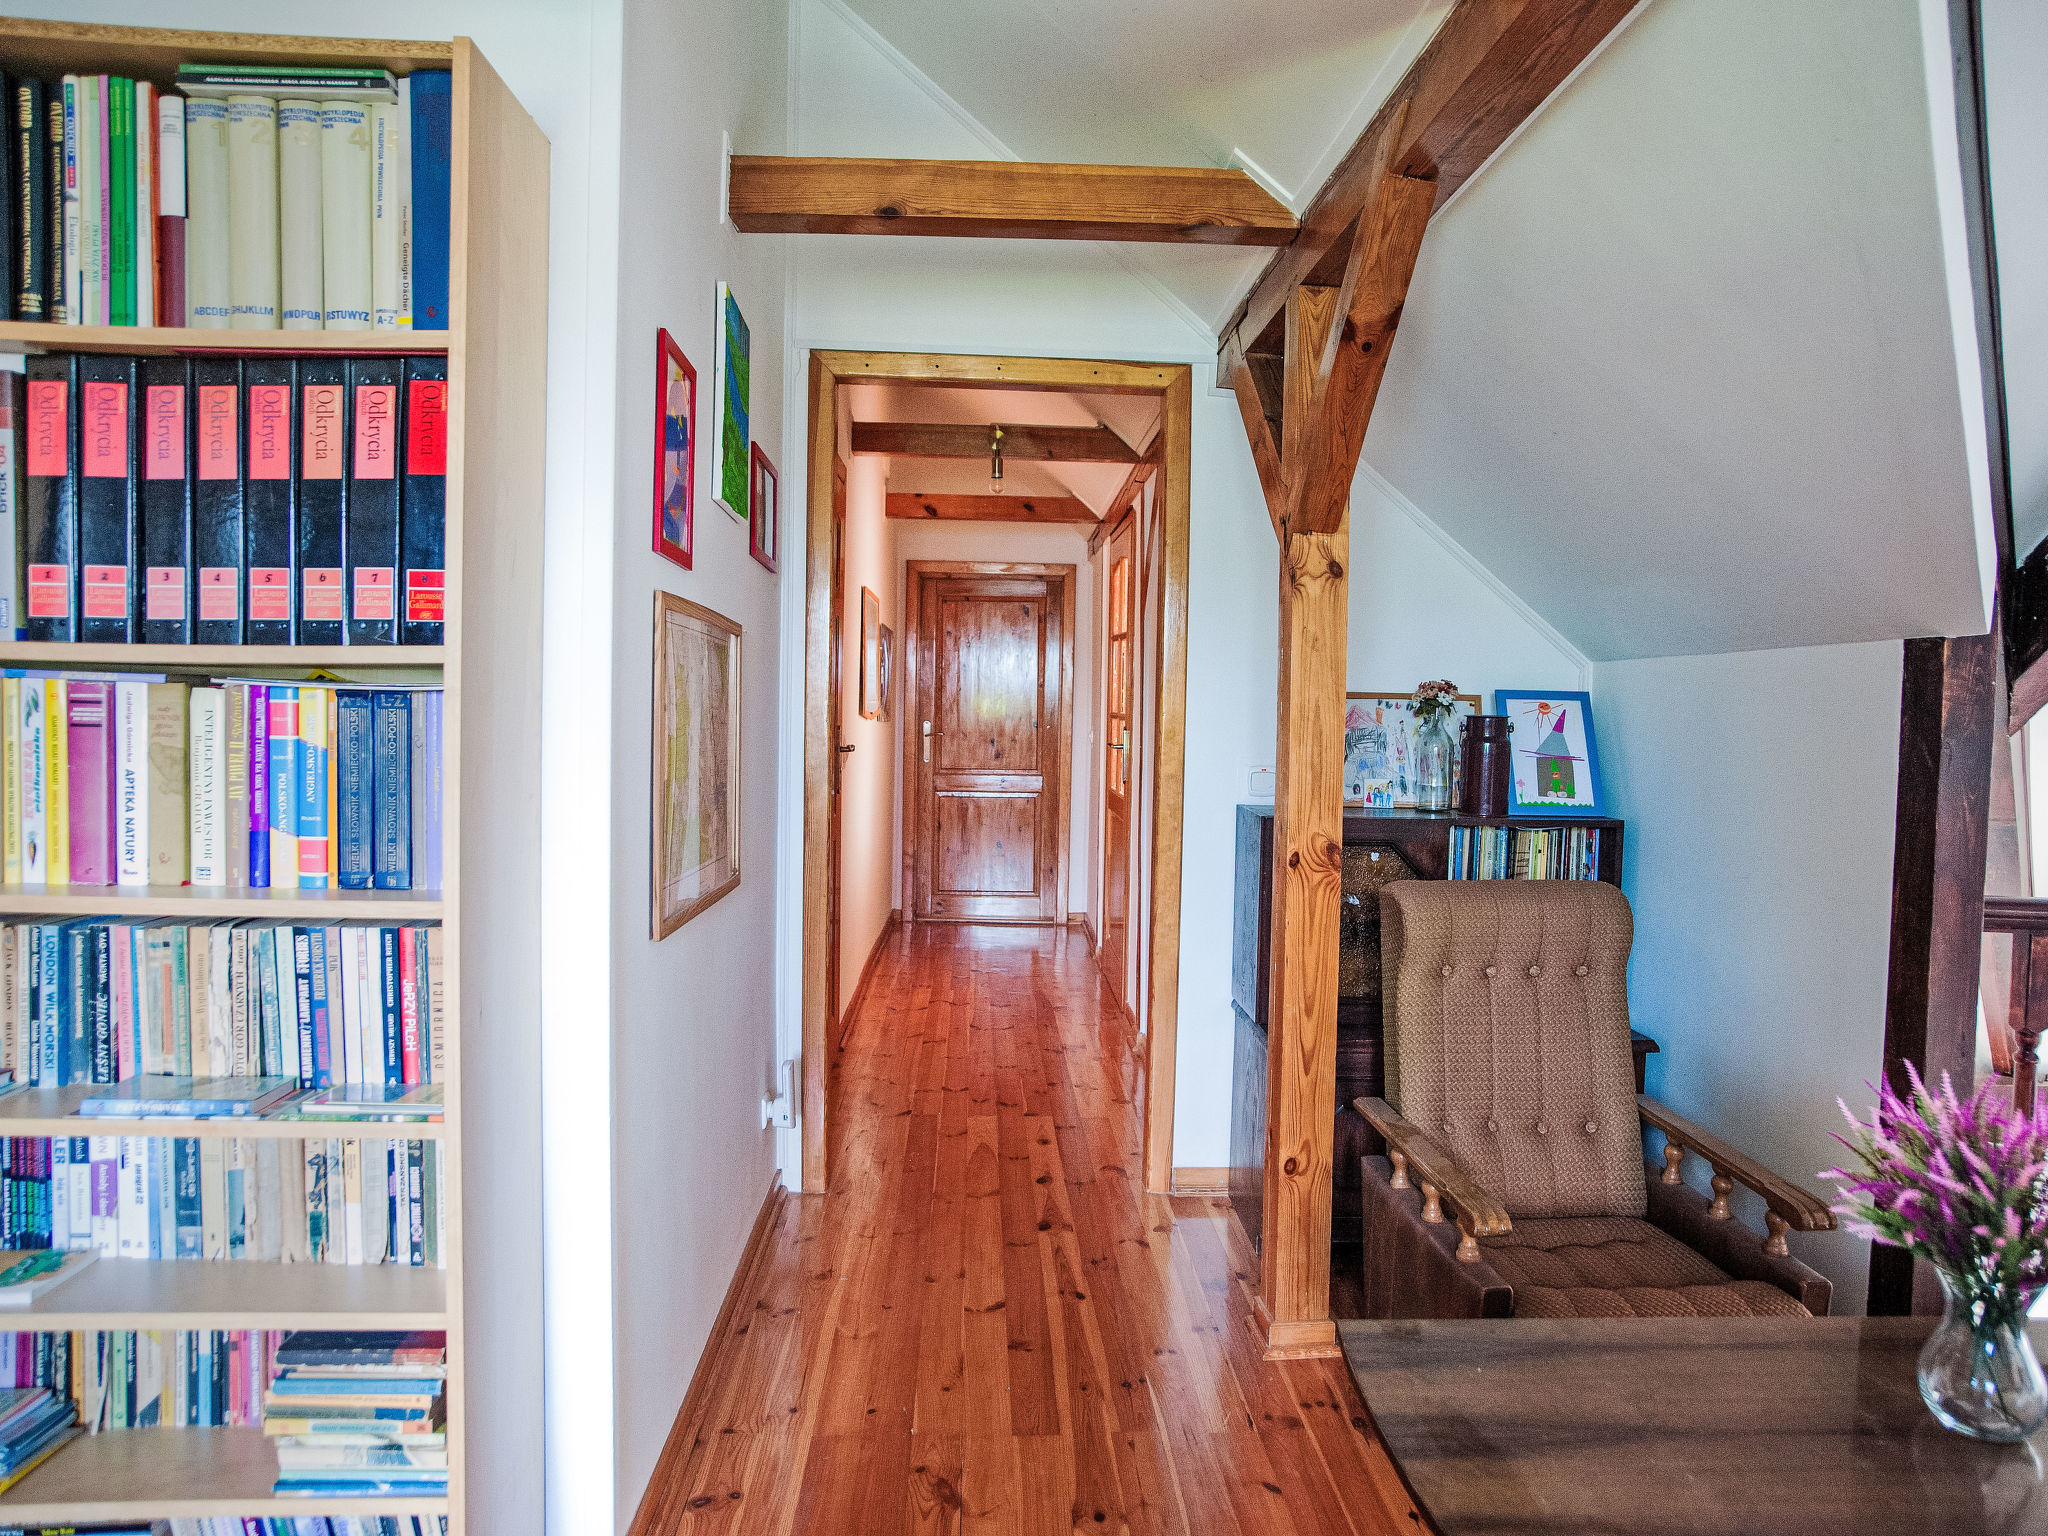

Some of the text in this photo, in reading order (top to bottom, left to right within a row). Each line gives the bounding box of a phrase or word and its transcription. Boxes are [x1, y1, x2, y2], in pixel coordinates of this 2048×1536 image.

[401, 242, 410, 280] Geneigte
[377, 315, 394, 325] A-Z
[402, 283, 410, 312] Dächer
[33, 385, 58, 456] Odkrycia
[90, 387, 119, 457] Odkrycia
[153, 390, 177, 459] Odkrycia
[205, 390, 229, 459] Odkrycia
[256, 390, 281, 459] Odkrycia
[310, 390, 334, 460] Odkrycia
[362, 391, 387, 460] Odkrycia
[414, 385, 440, 455] Odkrycia
[409, 600, 444, 609] Gallimard
[411, 590, 442, 600] Larousse
[380, 694, 404, 707] L-Z
[125, 768, 135, 812] APTEKA
[204, 709, 214, 858] INTELIGENTNY INWESTOR
[229, 786, 243, 800] JAN
[387, 708, 396, 872] WIELKI SŁOWNIK NIEMIECKO-POLSKI
[125, 817, 135, 862] NATURY
[351, 796, 360, 838] SŁOWNIK
[352, 842, 360, 872] WIELKI
[311, 933, 325, 1000] FREDERICK FORSYTH
[385, 934, 393, 956] REICH
[44, 935, 55, 1069] LONDON WILK MORSKI
[235, 971, 245, 1022] CZARNYCH
[386, 957, 394, 1007] CHRISTOPHER
[96, 993, 108, 1041] GONIEC
[298, 979, 312, 1078] KAMIENNY LAMPART
[96, 1042, 109, 1080] LEŚNY
[54, 1138, 66, 1164] LER
